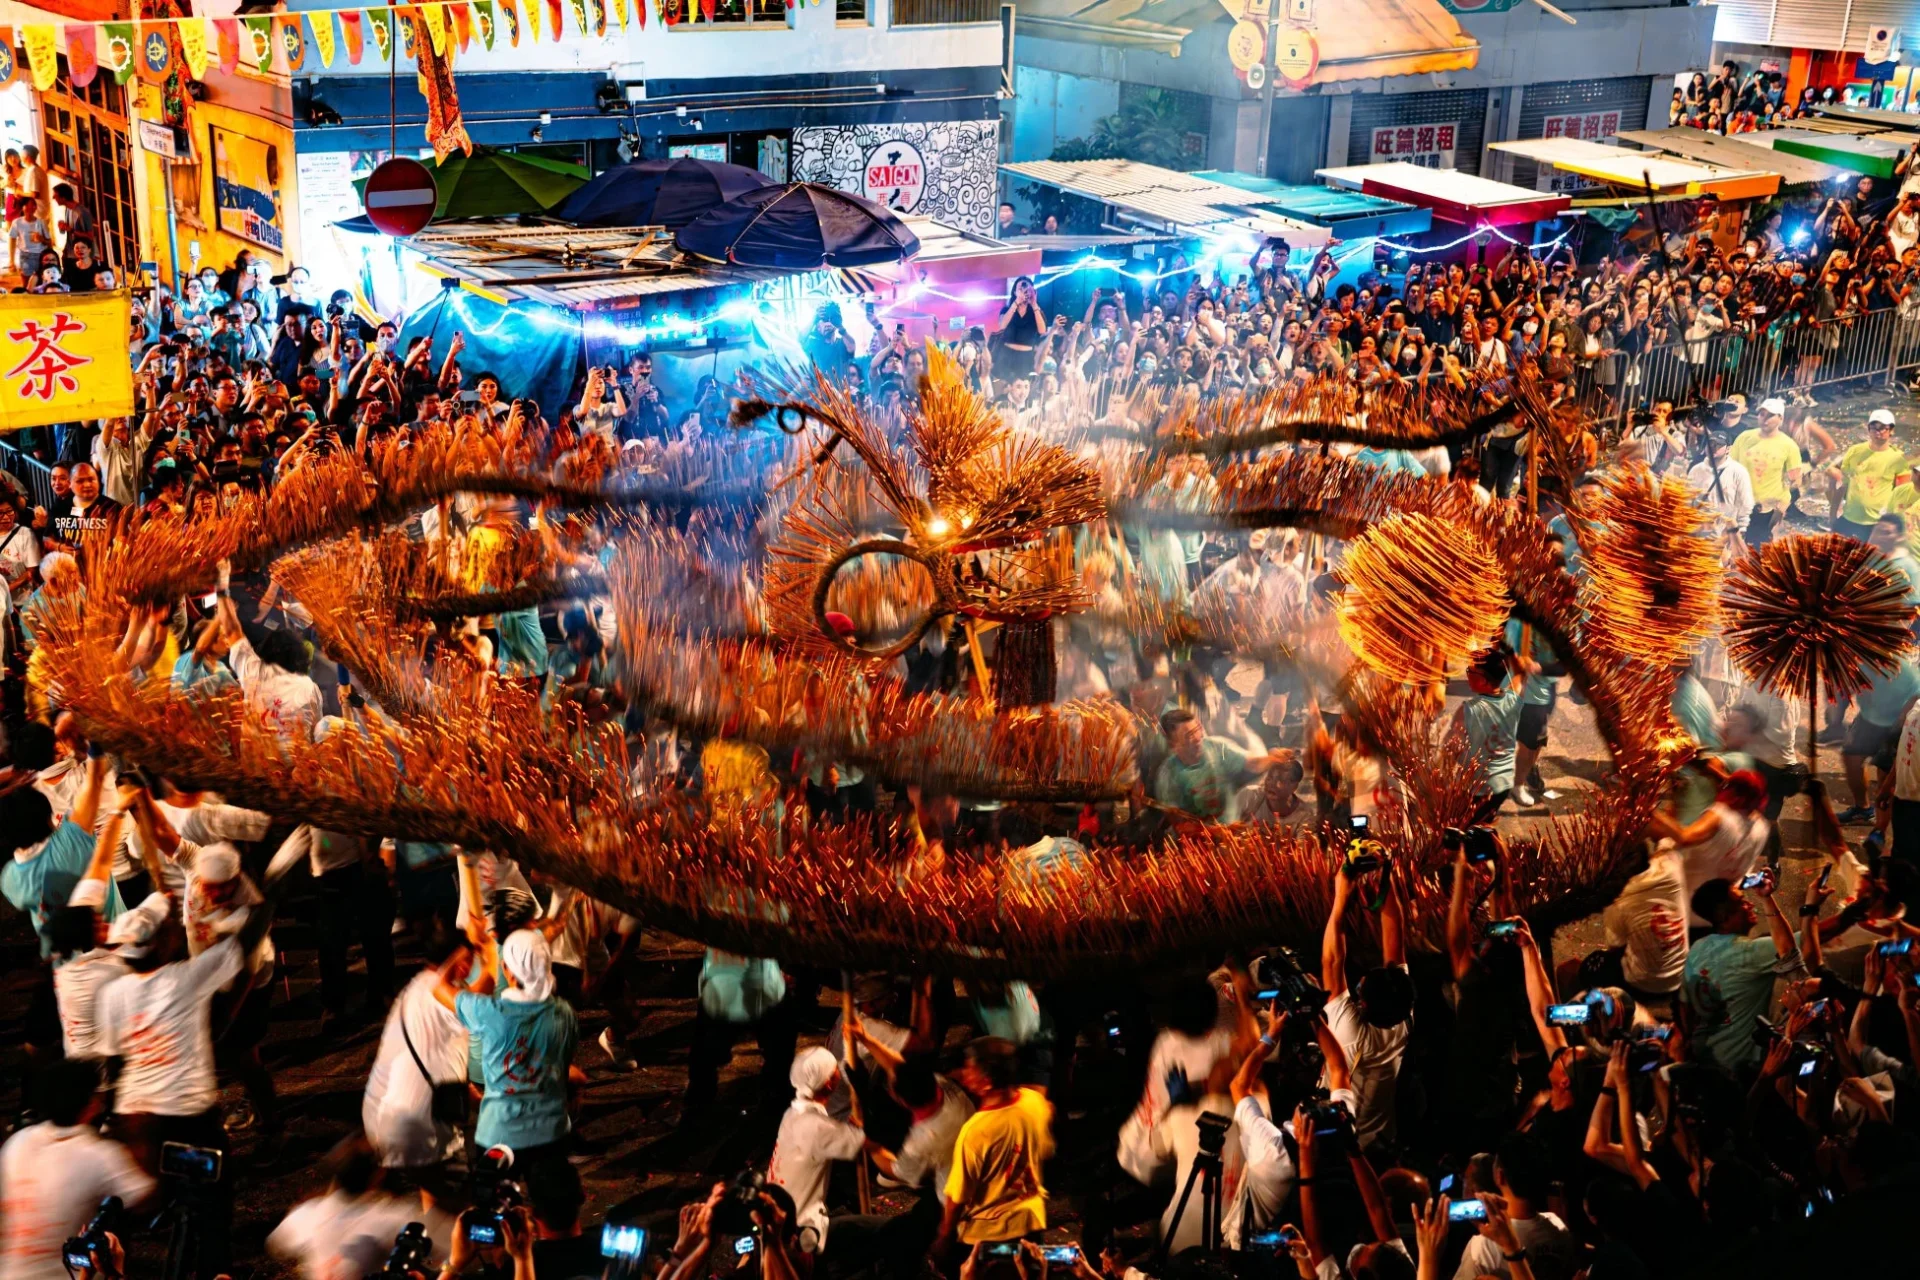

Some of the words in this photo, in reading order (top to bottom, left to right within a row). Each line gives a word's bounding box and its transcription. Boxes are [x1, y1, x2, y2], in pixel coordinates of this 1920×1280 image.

[1375, 126, 1454, 154] 旺鋪招租
[870, 166, 919, 186] SAIGON
[6, 313, 92, 401] 茶
[55, 517, 108, 529] GREATNESS
